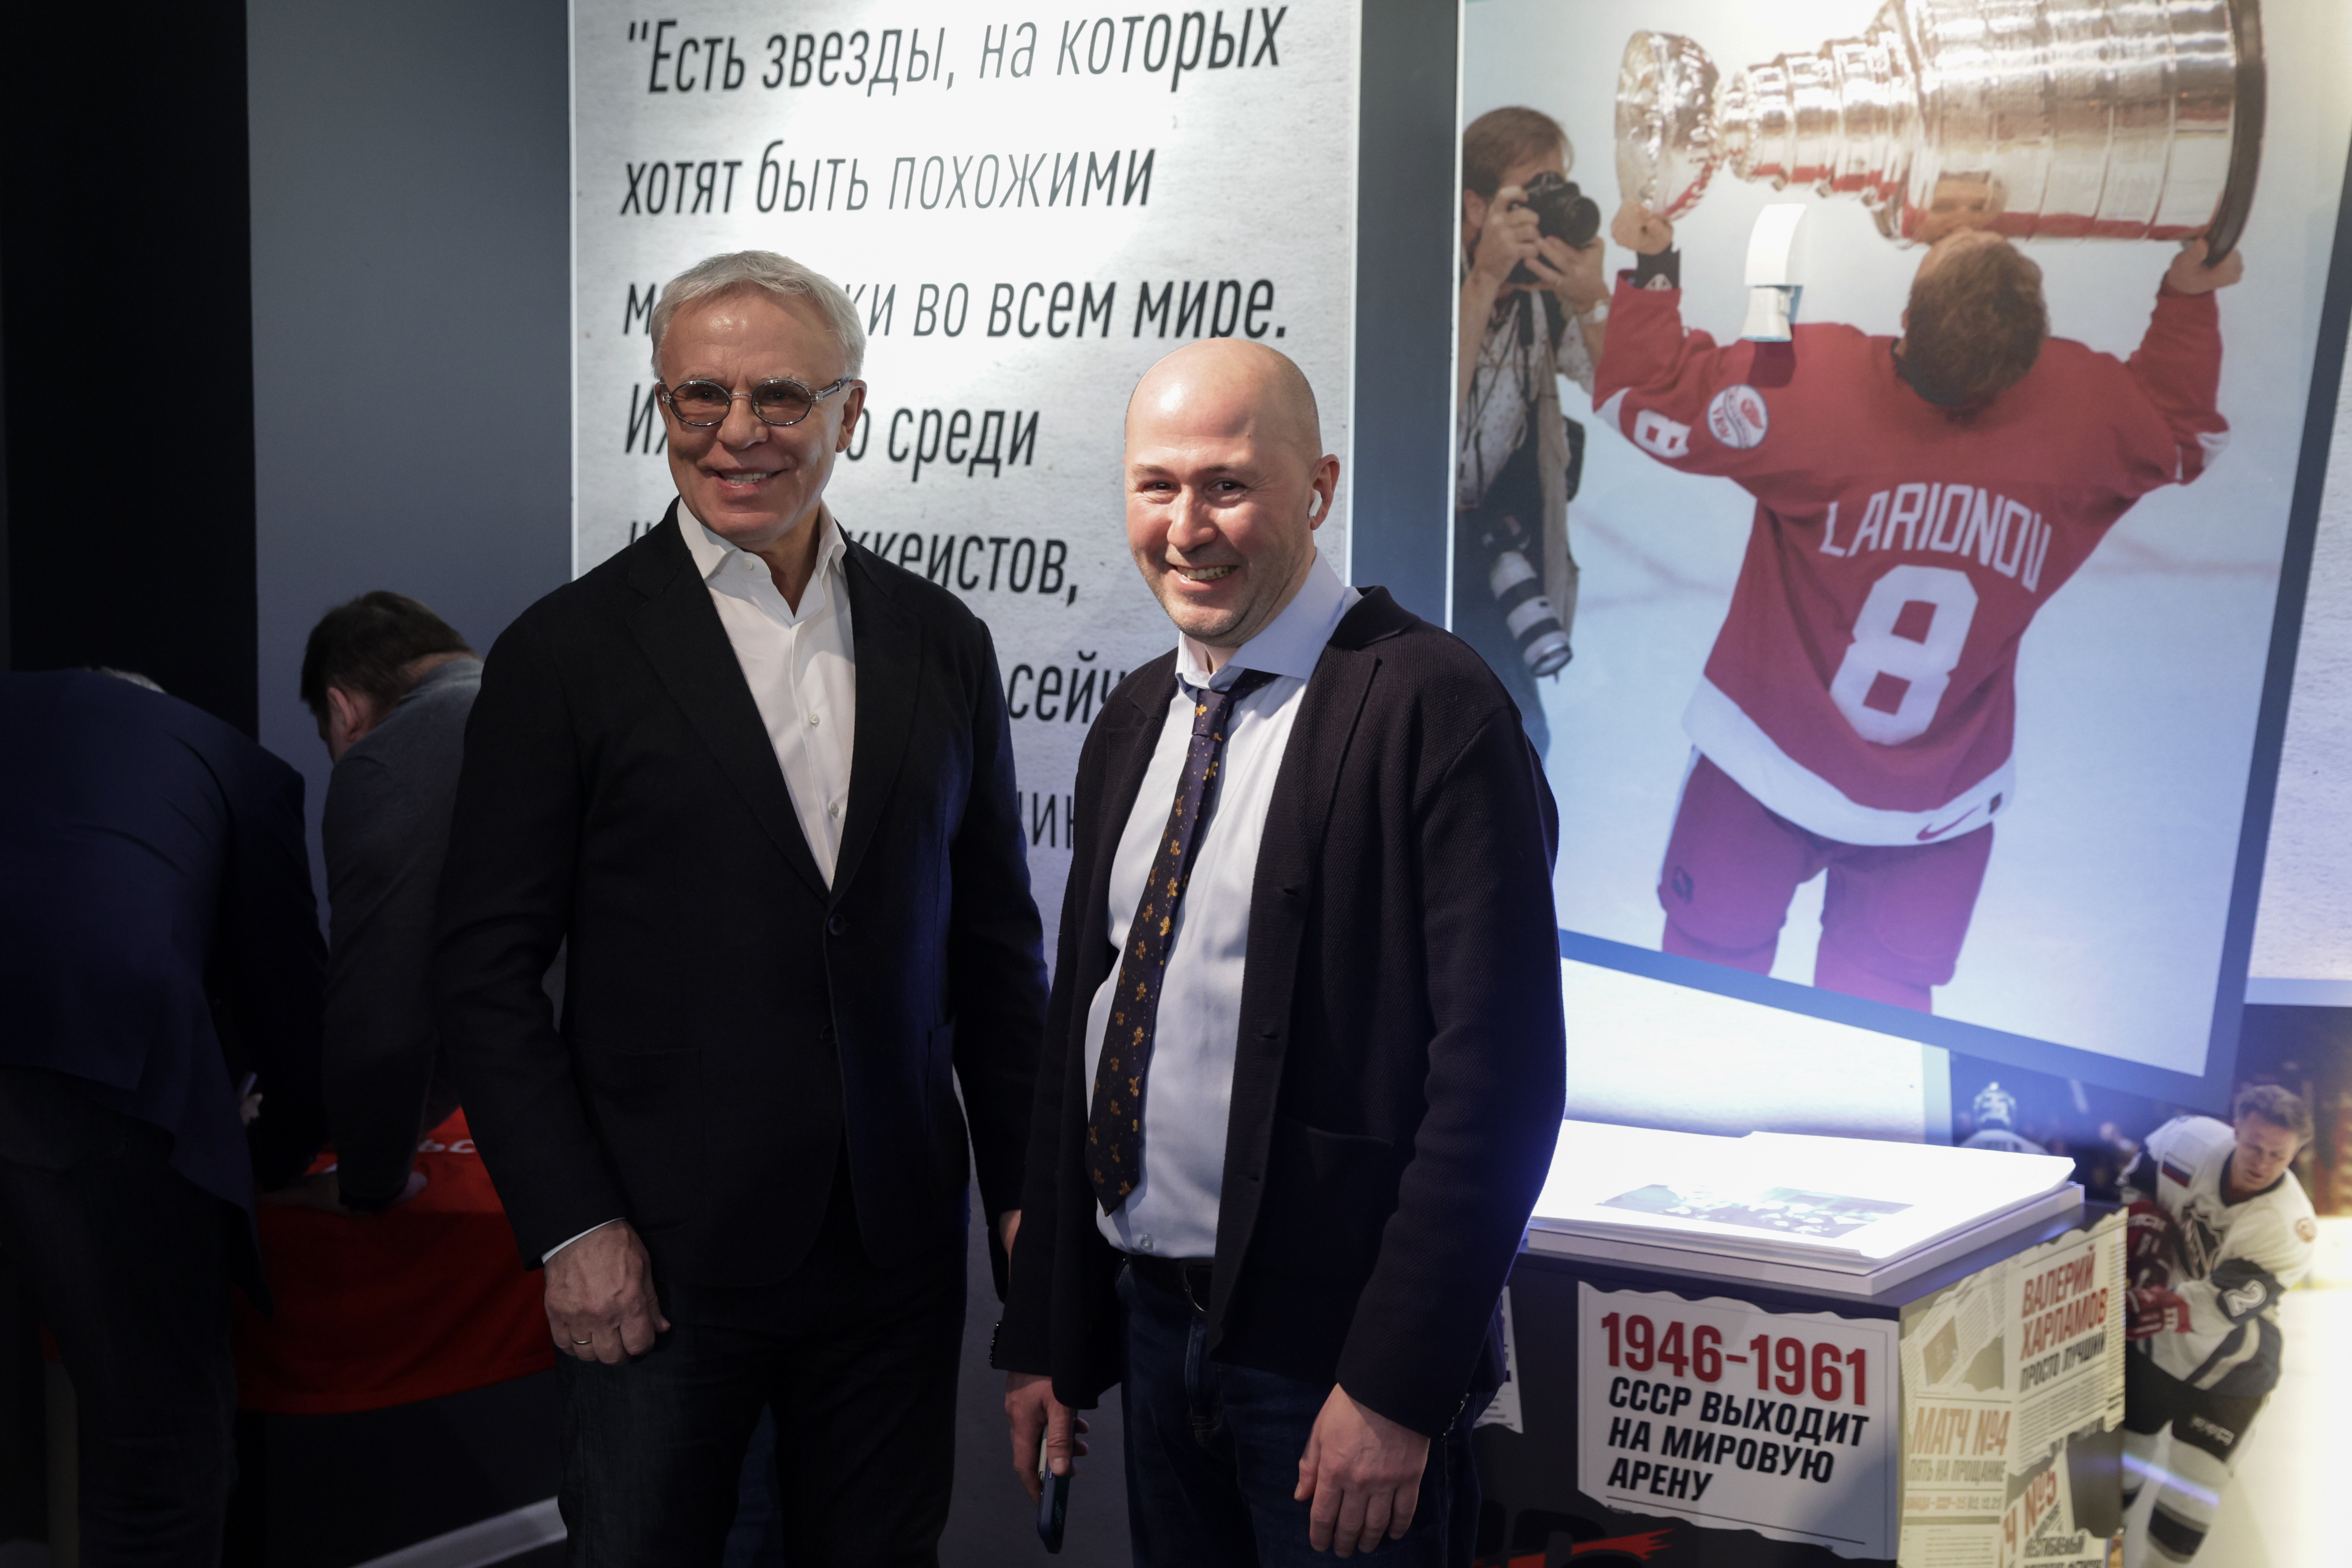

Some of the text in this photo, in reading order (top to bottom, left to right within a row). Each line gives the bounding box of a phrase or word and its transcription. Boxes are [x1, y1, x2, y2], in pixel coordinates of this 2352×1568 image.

[628, 5, 1289, 97] "Есть звезды, на которых
[620, 139, 1156, 215] хотят быть похожими
[913, 282, 969, 337] во
[986, 281, 1117, 339] всем
[1133, 279, 1286, 339] мире.
[888, 408, 1040, 483] среди
[847, 531, 1078, 606] кеистов,
[1818, 482, 2052, 593] LARIONOV
[1008, 651, 1126, 723] сей
[1829, 564, 1979, 746] 8
[2021, 1244, 2096, 1318] ВАЛЕРИЙ
[1601, 1311, 1866, 1406] 1946–1961
[2019, 1325, 2107, 1392] ПРОСТО ЛУЧШИЙ
[2020, 1287, 2108, 1361] ХАРЛАМОВ
[1609, 1376, 1869, 1447] СССР ВЫХОДИТ
[1911, 1407, 1972, 1455] МАТЧ
[1607, 1458, 1713, 1502] АРЕНУ
[1608, 1417, 1834, 1483] НА МИРОВУЮ
